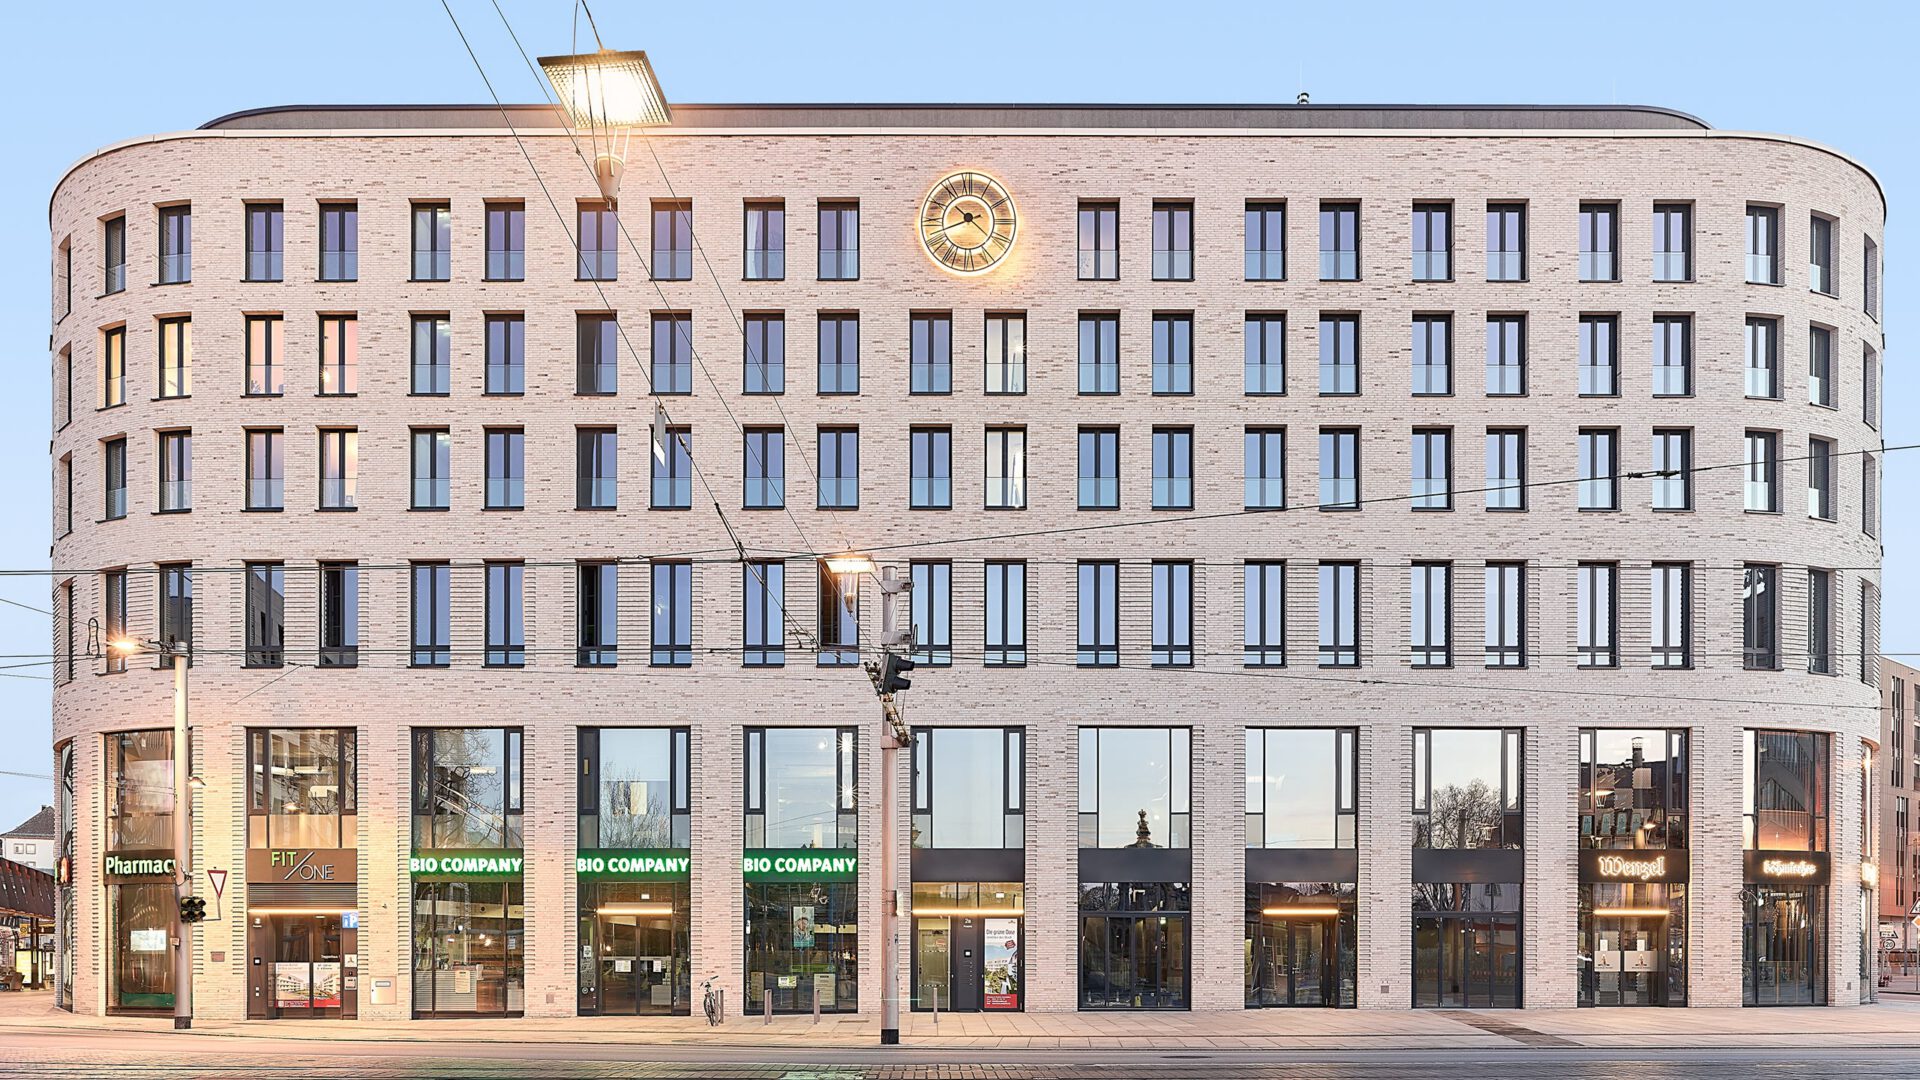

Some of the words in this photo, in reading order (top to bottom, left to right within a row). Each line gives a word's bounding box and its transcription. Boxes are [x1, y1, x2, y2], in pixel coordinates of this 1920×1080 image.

[271, 851, 297, 867] FIT
[410, 858, 438, 872] BIO
[440, 858, 523, 872] COMPANY
[576, 858, 604, 872] BIO
[607, 858, 690, 872] COMPANY
[743, 858, 771, 872] BIO
[774, 858, 857, 872] COMPANY
[299, 865, 334, 880] ONE
[1598, 856, 1666, 880] Wenzel
